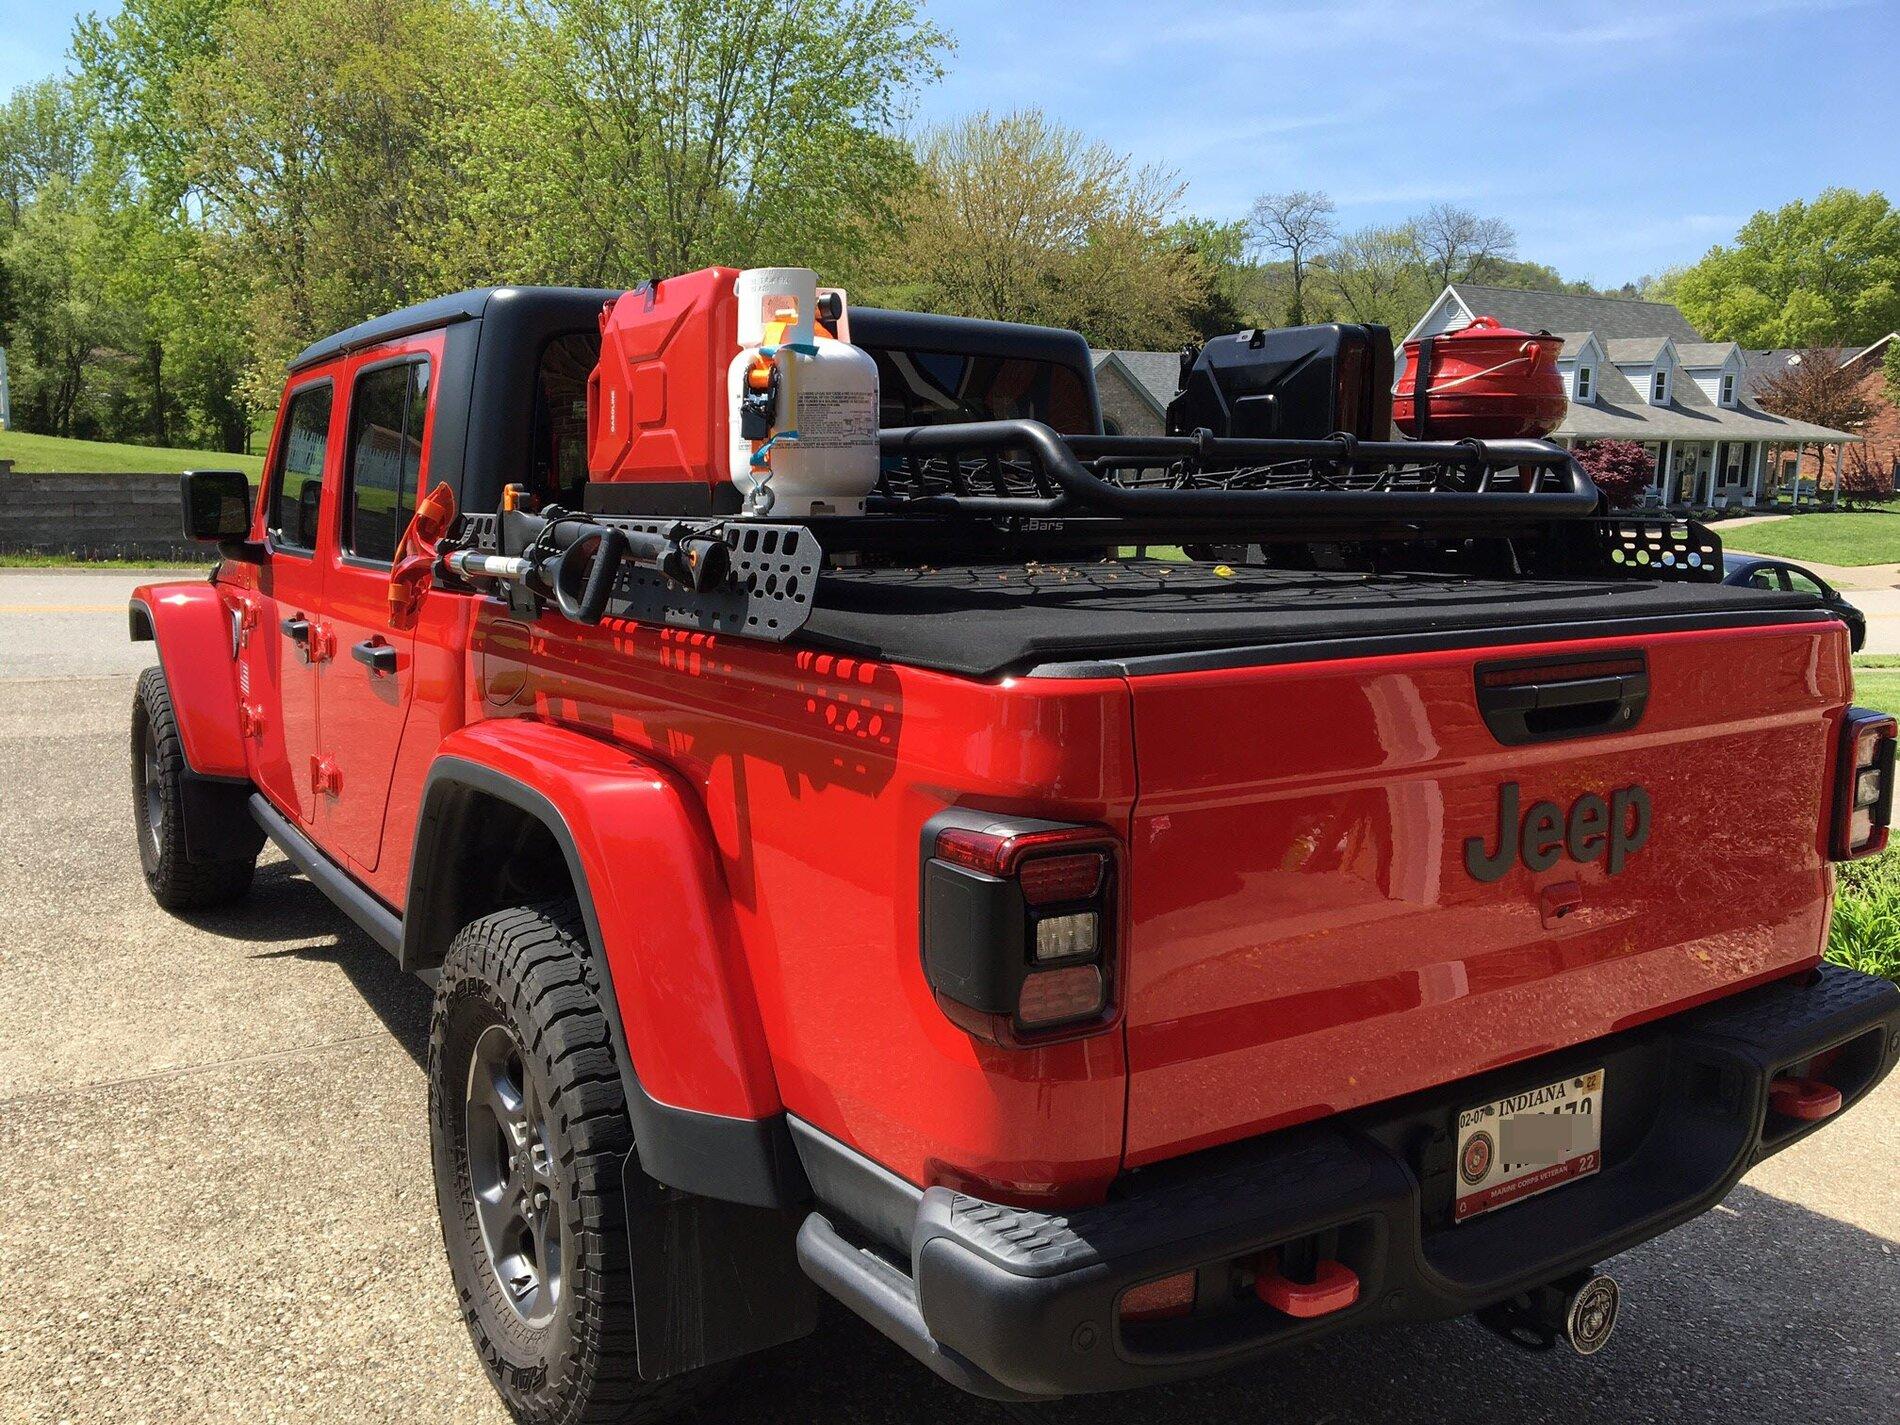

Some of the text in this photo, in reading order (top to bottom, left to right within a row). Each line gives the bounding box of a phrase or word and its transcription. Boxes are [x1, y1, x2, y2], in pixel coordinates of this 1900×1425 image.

[1464, 781, 1653, 883] Jeep
[1587, 1075, 1596, 1088] 22
[1498, 1083, 1566, 1117] INDIANA
[1460, 1108, 1486, 1128] 02-07
[1579, 1155, 1595, 1172] 22
[1490, 1183, 1517, 1198] MARINE
[1517, 1175, 1539, 1188] CORPS
[1540, 1165, 1568, 1183] VETERAN
